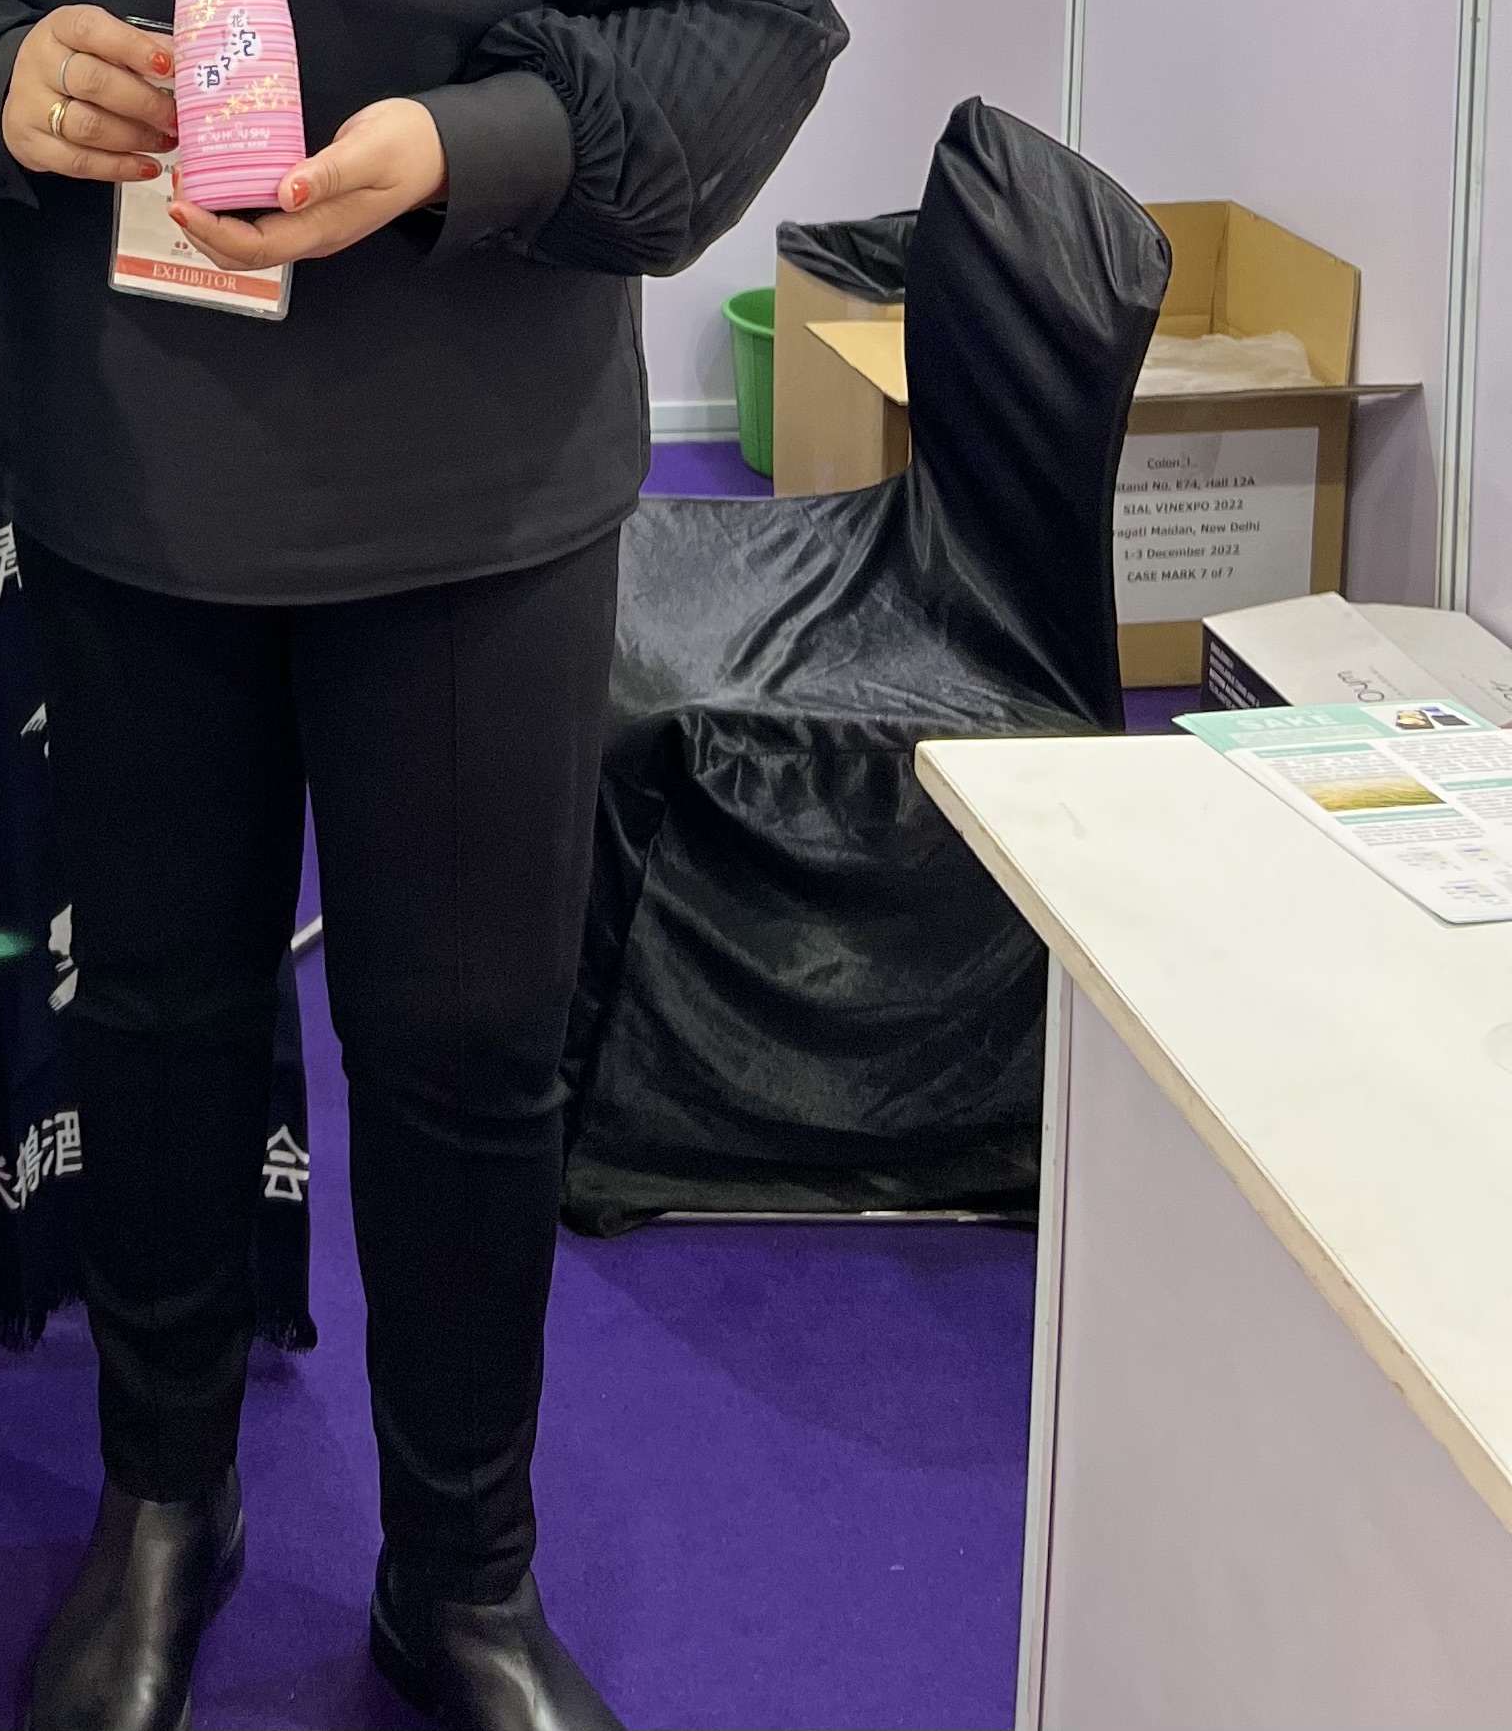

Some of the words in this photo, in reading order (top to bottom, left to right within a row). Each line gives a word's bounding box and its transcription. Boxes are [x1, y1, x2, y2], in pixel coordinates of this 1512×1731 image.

[152, 263, 238, 291] EXHIBITOR
[1152, 479, 1172, 491] No.
[1234, 476, 1256, 487] 12A
[1123, 504, 1150, 515] SIAL
[1156, 501, 1210, 513] VINEXPO
[1214, 499, 1244, 511] 2022
[1113, 526, 1147, 539] ragati
[1201, 522, 1226, 534] New
[1230, 520, 1261, 533] Delhi
[1147, 547, 1206, 559] December
[1210, 544, 1240, 556] 2022
[1127, 572, 1157, 583] CASE
[1161, 570, 1196, 581] MARK
[1211, 567, 1223, 579] of
